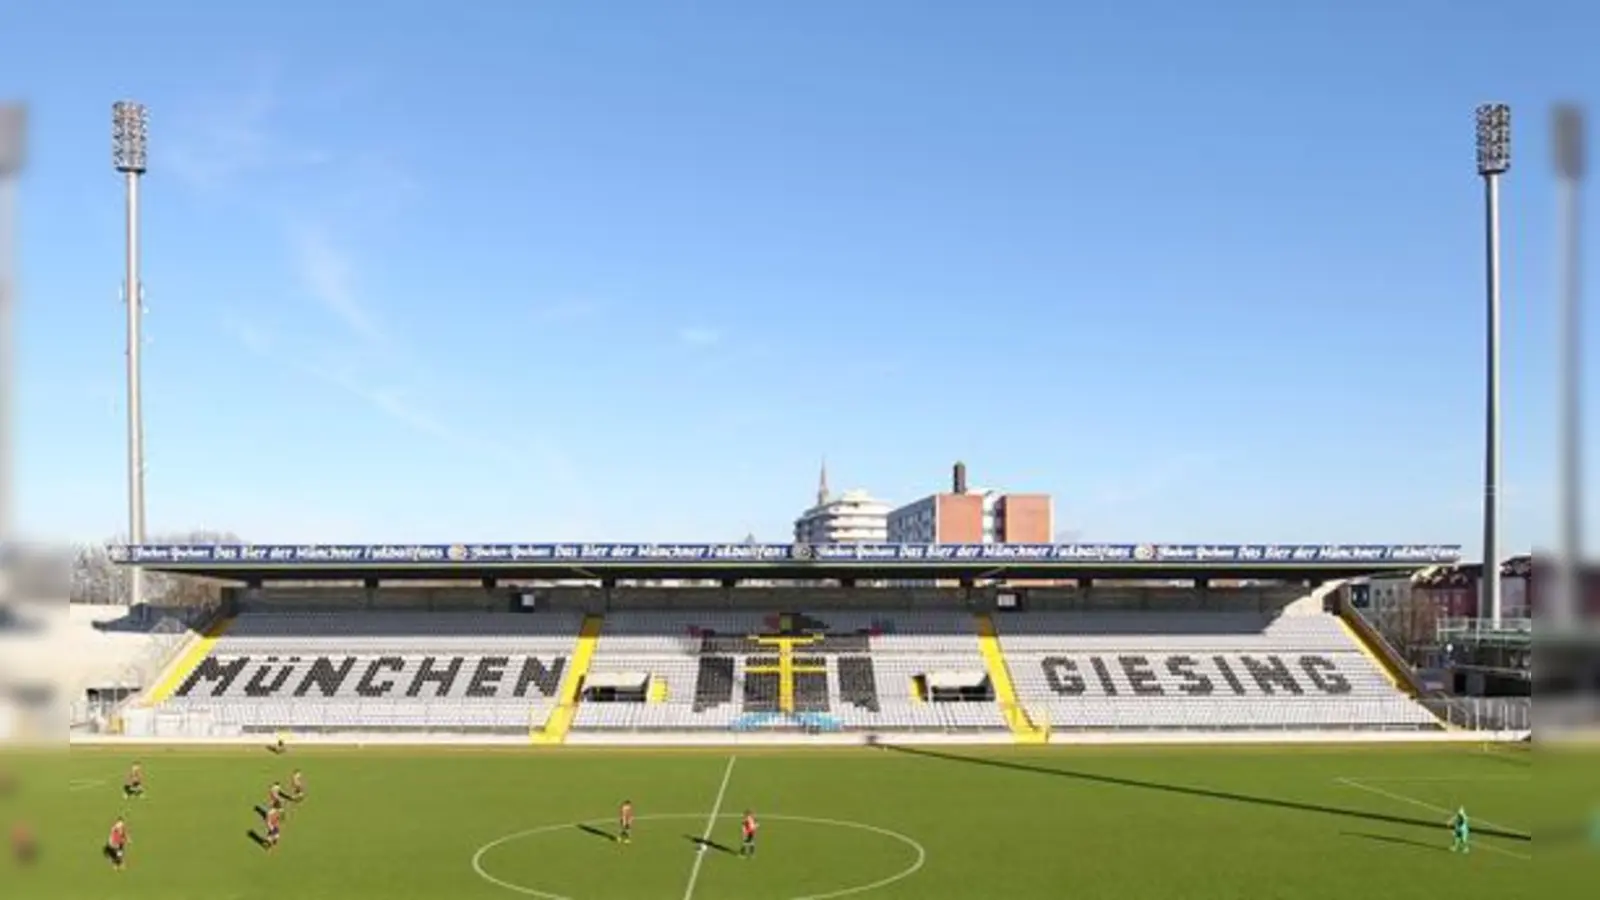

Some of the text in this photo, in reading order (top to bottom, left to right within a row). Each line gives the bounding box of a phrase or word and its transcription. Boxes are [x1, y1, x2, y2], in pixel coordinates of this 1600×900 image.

[214, 545, 237, 558] Das
[555, 545, 578, 558] Das
[900, 545, 923, 558] Das
[175, 656, 564, 697] MÜNCHEN
[1040, 655, 1352, 696] GIESING
